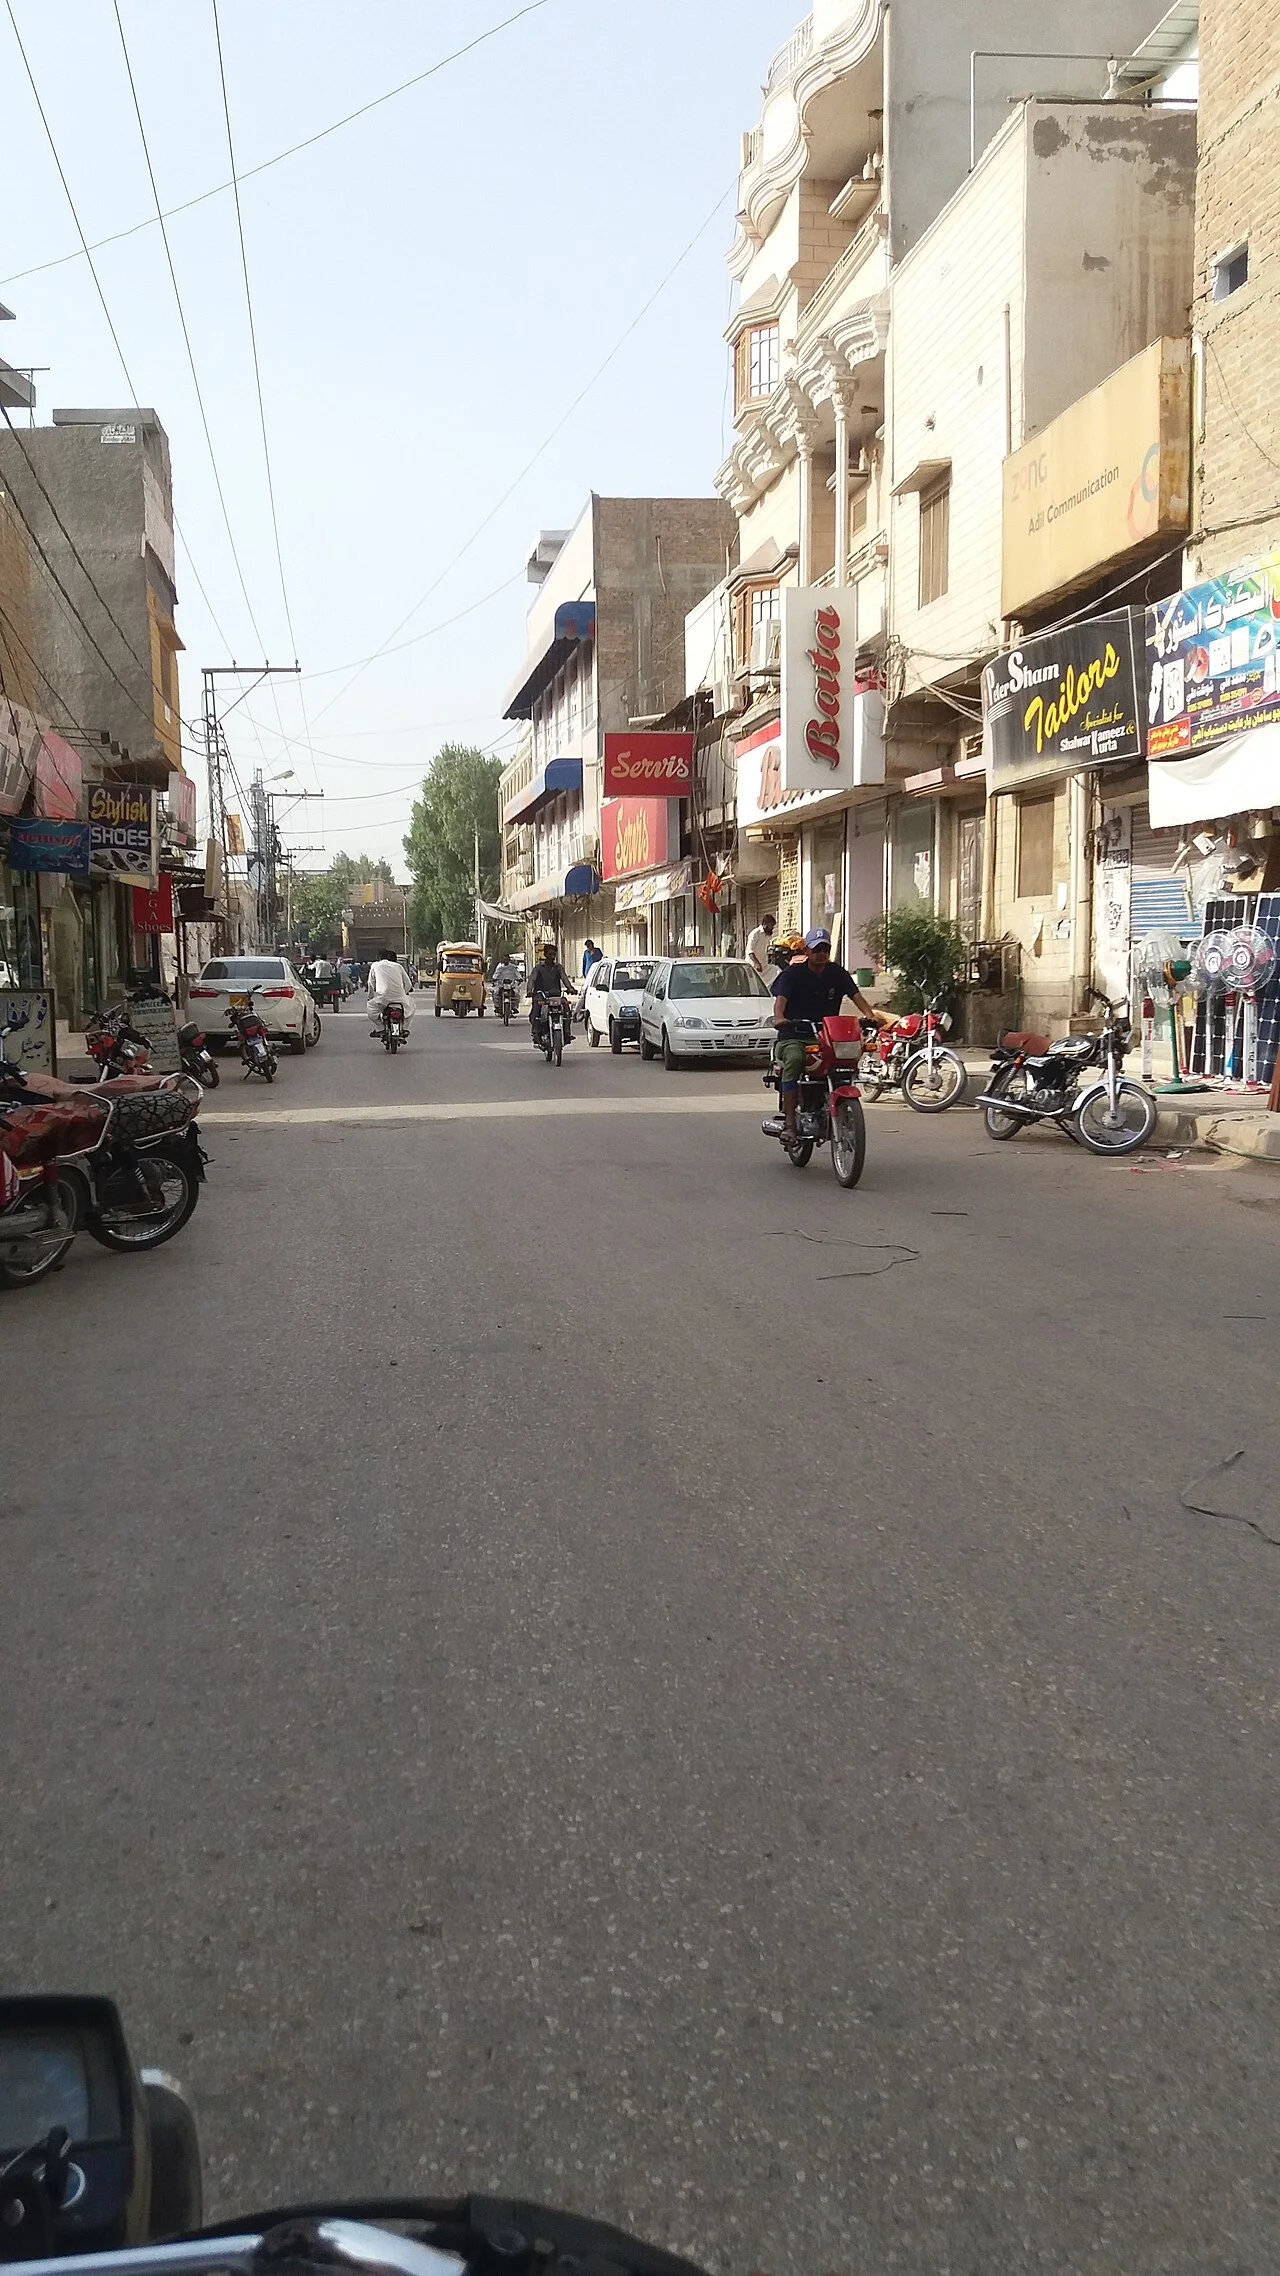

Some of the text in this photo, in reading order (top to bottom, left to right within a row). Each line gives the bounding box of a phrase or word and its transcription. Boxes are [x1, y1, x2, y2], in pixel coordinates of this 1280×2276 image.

[1047, 465, 1120, 524] Communication
[804, 604, 841, 771] Bata
[1024, 642, 1120, 753] Tailors
[1112, 702, 1124, 724] for
[1060, 735, 1091, 751] Shalwar
[610, 751, 690, 779] Servis
[90, 788, 149, 826] Stylish
[91, 826, 149, 847] SHOES
[615, 805, 649, 871] Servis
[137, 921, 171, 932] Shoes
